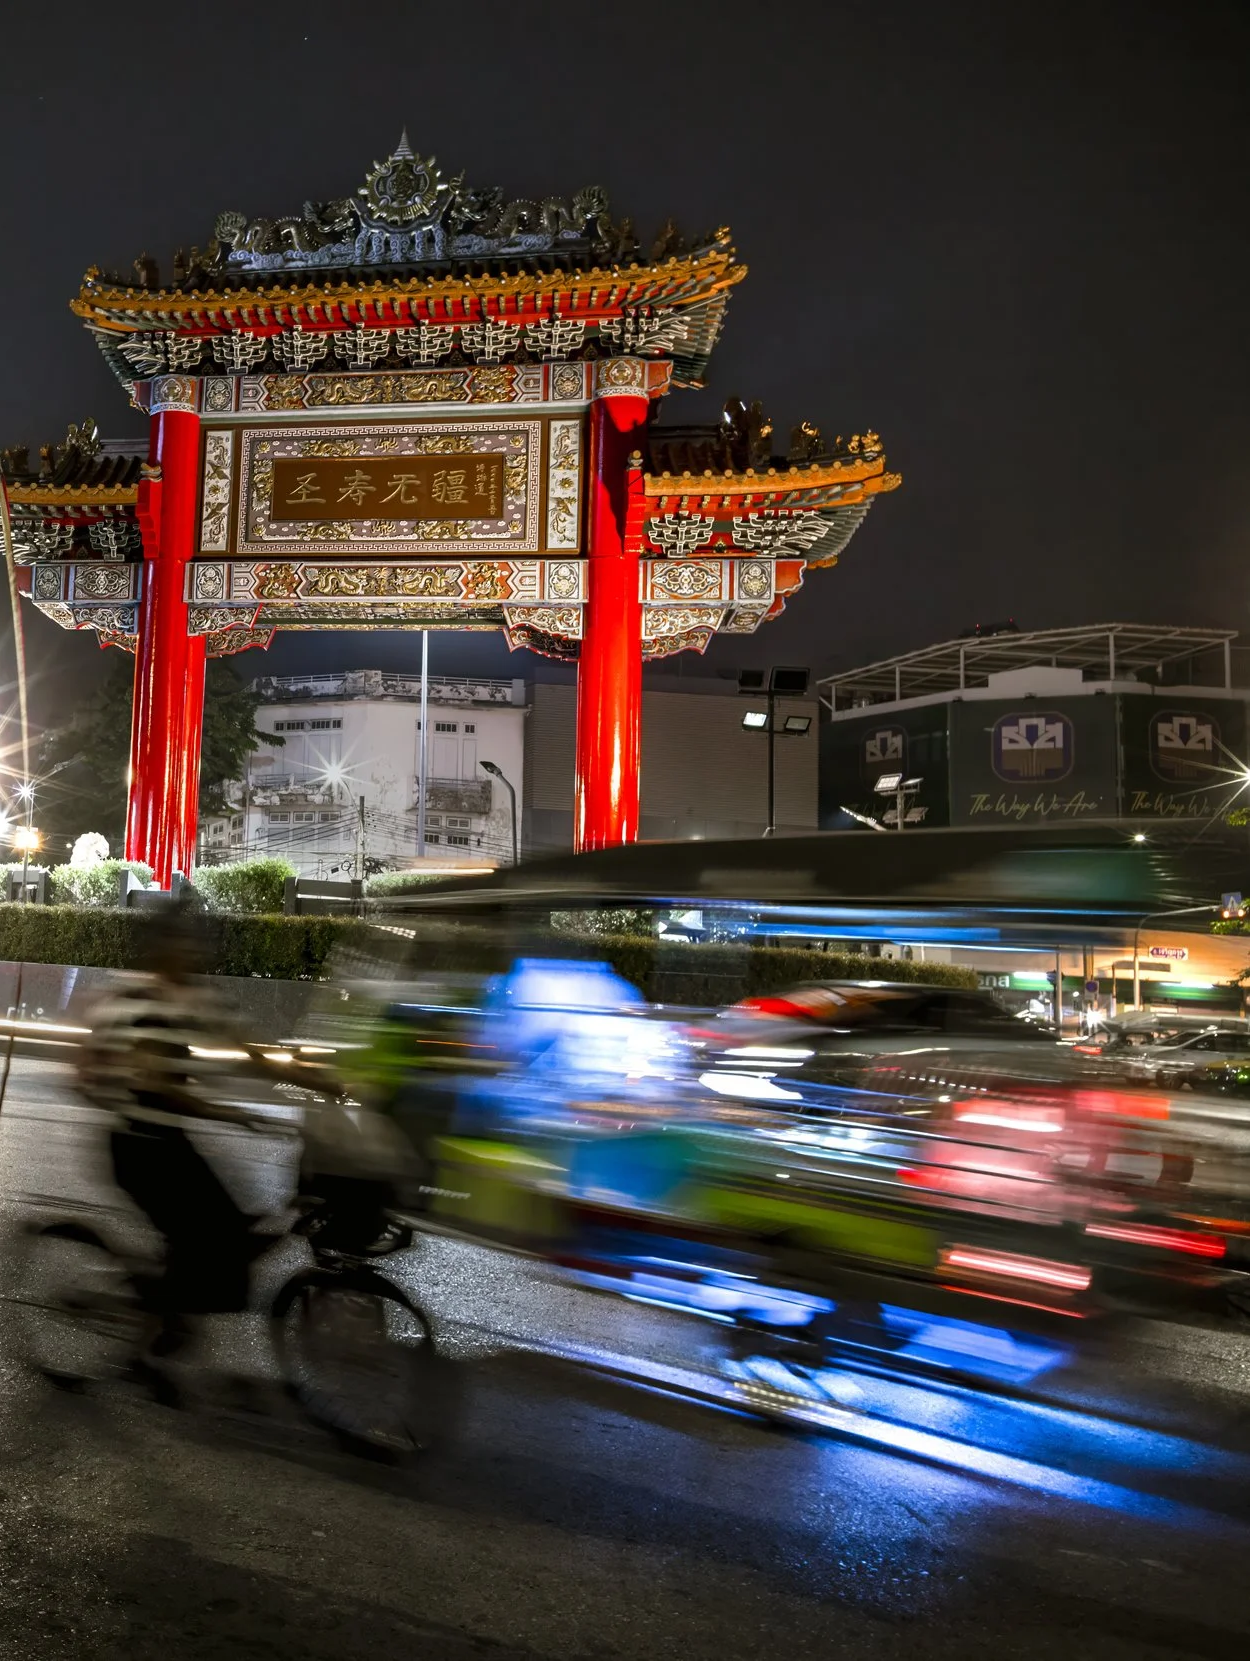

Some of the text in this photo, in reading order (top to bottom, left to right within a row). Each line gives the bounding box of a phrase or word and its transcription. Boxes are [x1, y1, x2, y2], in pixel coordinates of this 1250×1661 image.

[285, 469, 469, 506] 圣寿无疆
[970, 791, 1098, 820] The Way We Are
[1153, 793, 1185, 818] Way
